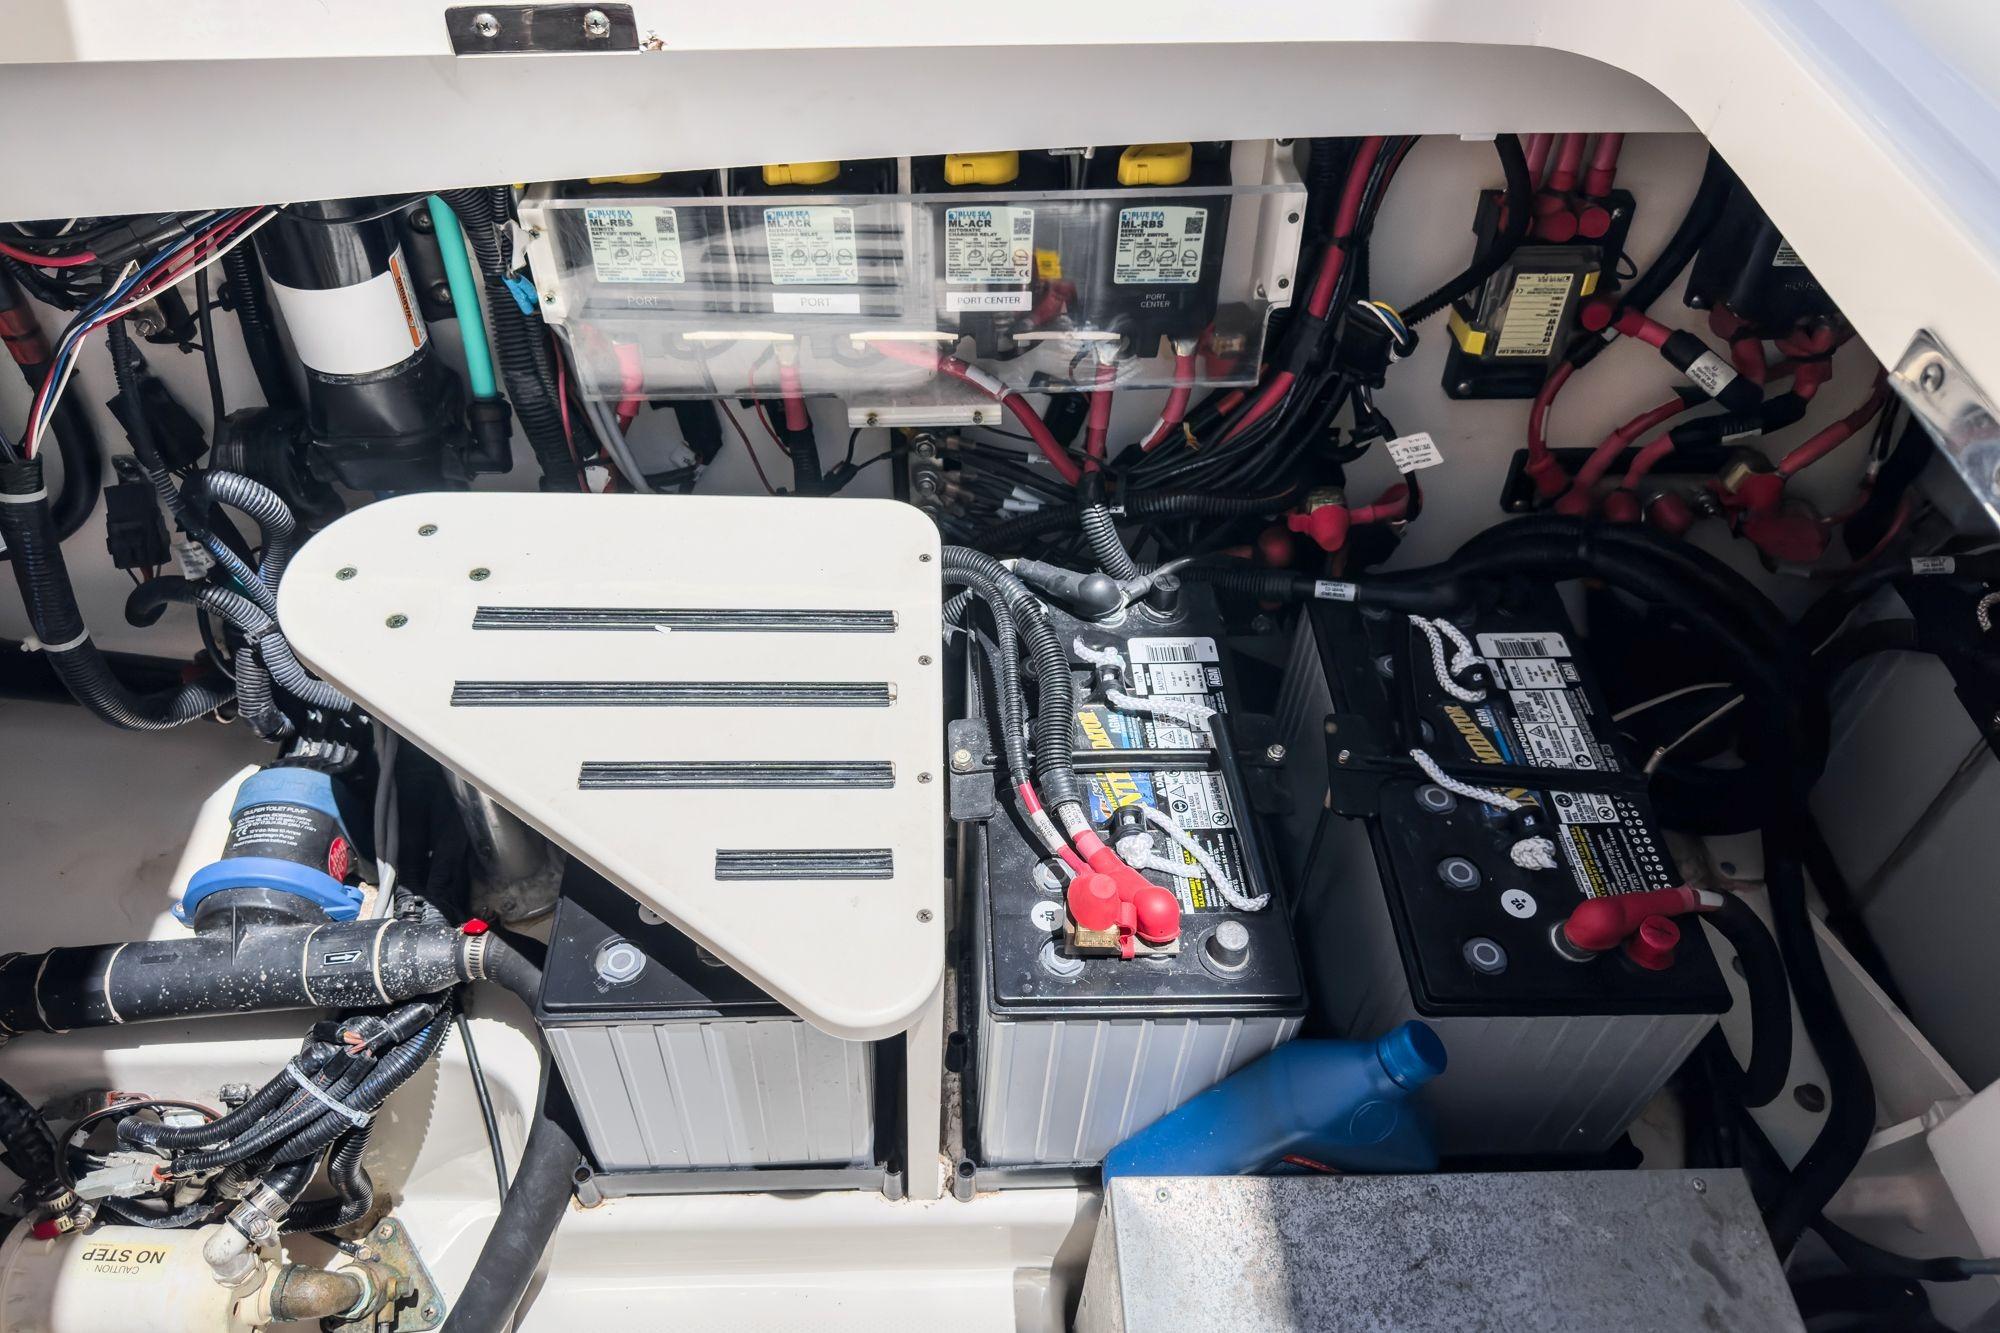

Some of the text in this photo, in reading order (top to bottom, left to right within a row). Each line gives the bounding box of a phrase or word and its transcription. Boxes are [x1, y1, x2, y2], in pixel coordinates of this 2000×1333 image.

[589, 219, 634, 227] ML-RBS
[767, 220, 811, 228] ML-ACR
[949, 220, 992, 228] ML-ACR
[1121, 220, 1164, 228] ML-RBS
[627, 296, 659, 306] PORT
[800, 297, 830, 307] PORT
[957, 296, 1021, 305] PORT CENTER
[1145, 293, 1166, 301] PORT
[1140, 300, 1171, 308] CENTER
[1207, 669, 1220, 684] AGM
[1561, 664, 1577, 680] AGM
[1475, 709, 1491, 726] AGM
[1107, 715, 1121, 732] AGM
[1143, 722, 1157, 747] OISON
[286, 806, 308, 814] PUMP
[1191, 808, 1199, 826] EXPLOSIVE
[1578, 866, 1587, 882] ATTEMPT
[1510, 897, 1525, 911] D2
[81, 1248, 166, 1264] NO STEP
[94, 1264, 140, 1275] CAUTION
